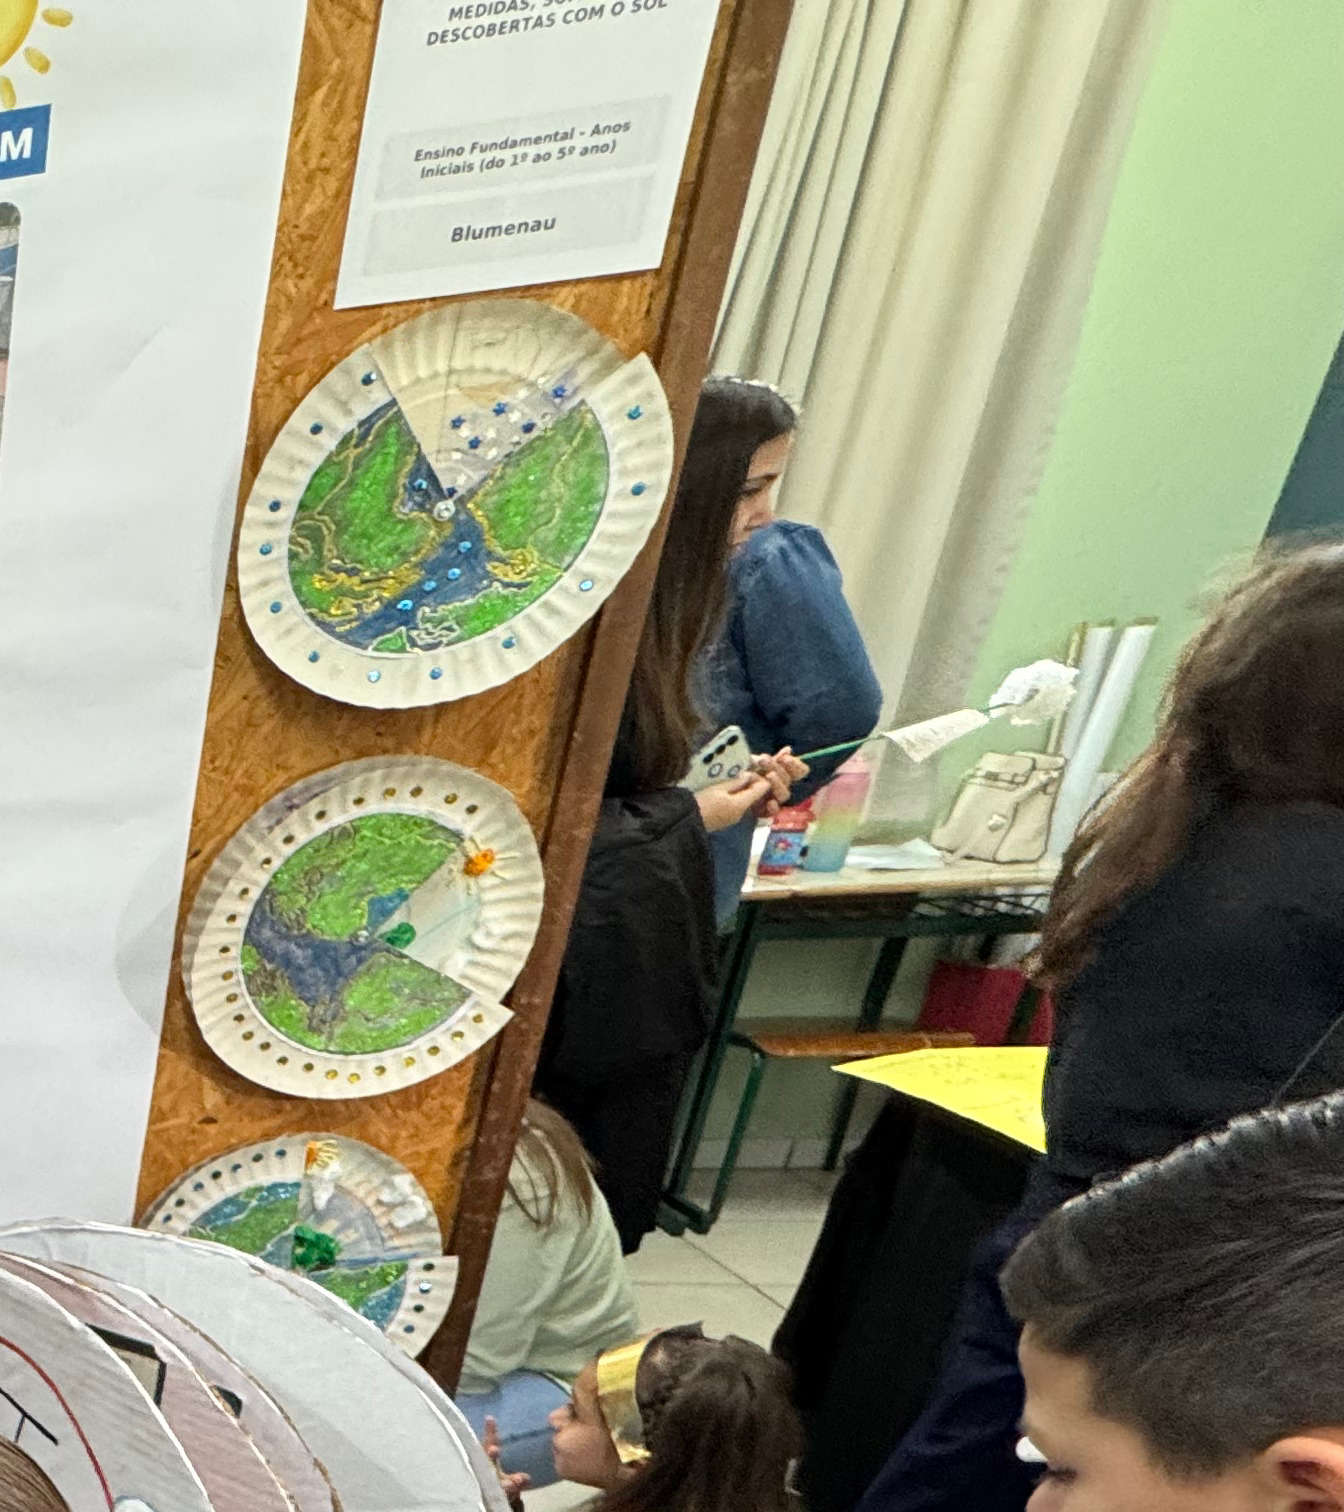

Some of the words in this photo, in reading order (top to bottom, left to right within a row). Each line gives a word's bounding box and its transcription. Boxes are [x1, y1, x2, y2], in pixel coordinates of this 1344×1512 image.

[426, 12, 557, 46] DESCOBERTAS
[561, 4, 605, 25] COM
[610, 1, 626, 17] O
[413, 142, 466, 164] Ensino
[469, 125, 576, 157] Fundamental
[590, 118, 632, 139] Anos
[420, 158, 475, 180] Iniciais
[479, 153, 506, 176] (do
[510, 151, 528, 168] 1º
[531, 149, 553, 165] ao
[555, 144, 577, 162] 5º
[578, 137, 618, 158] ano)
[450, 215, 557, 244] Blumenau
